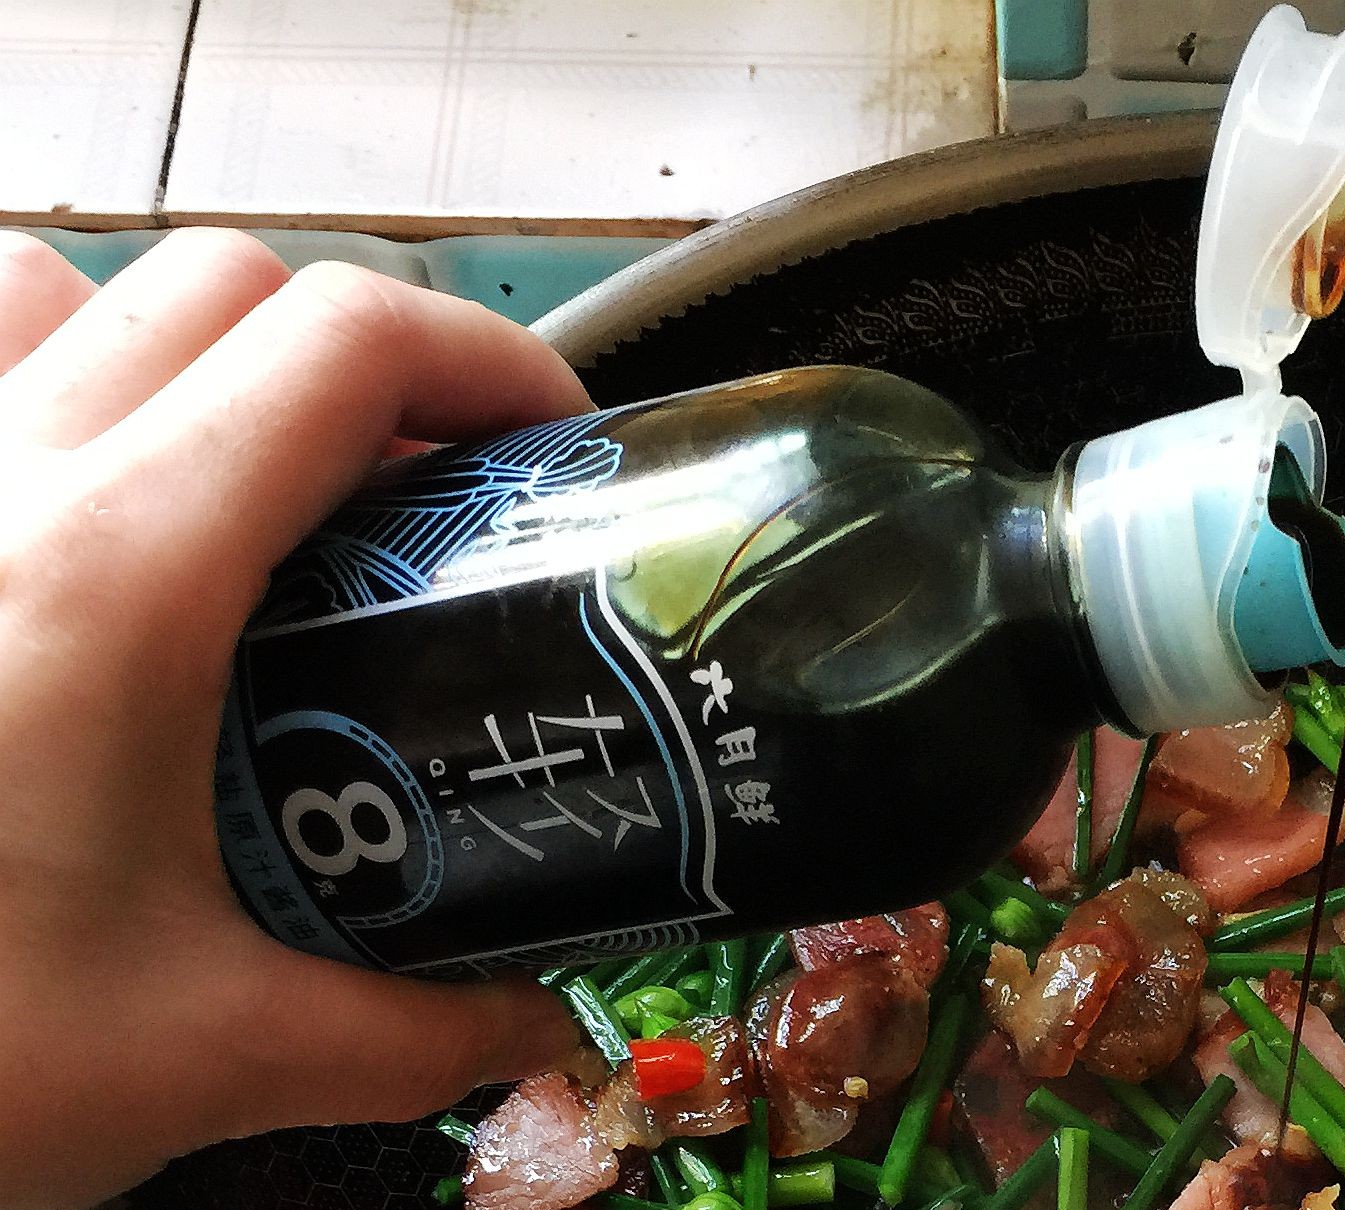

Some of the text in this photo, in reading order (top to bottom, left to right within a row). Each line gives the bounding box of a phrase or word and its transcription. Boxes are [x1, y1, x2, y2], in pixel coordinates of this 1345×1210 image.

[429, 758, 477, 851] QING
[468, 695, 660, 861] 轻
[689, 661, 779, 824] 六月鲜
[282, 781, 408, 876] 8
